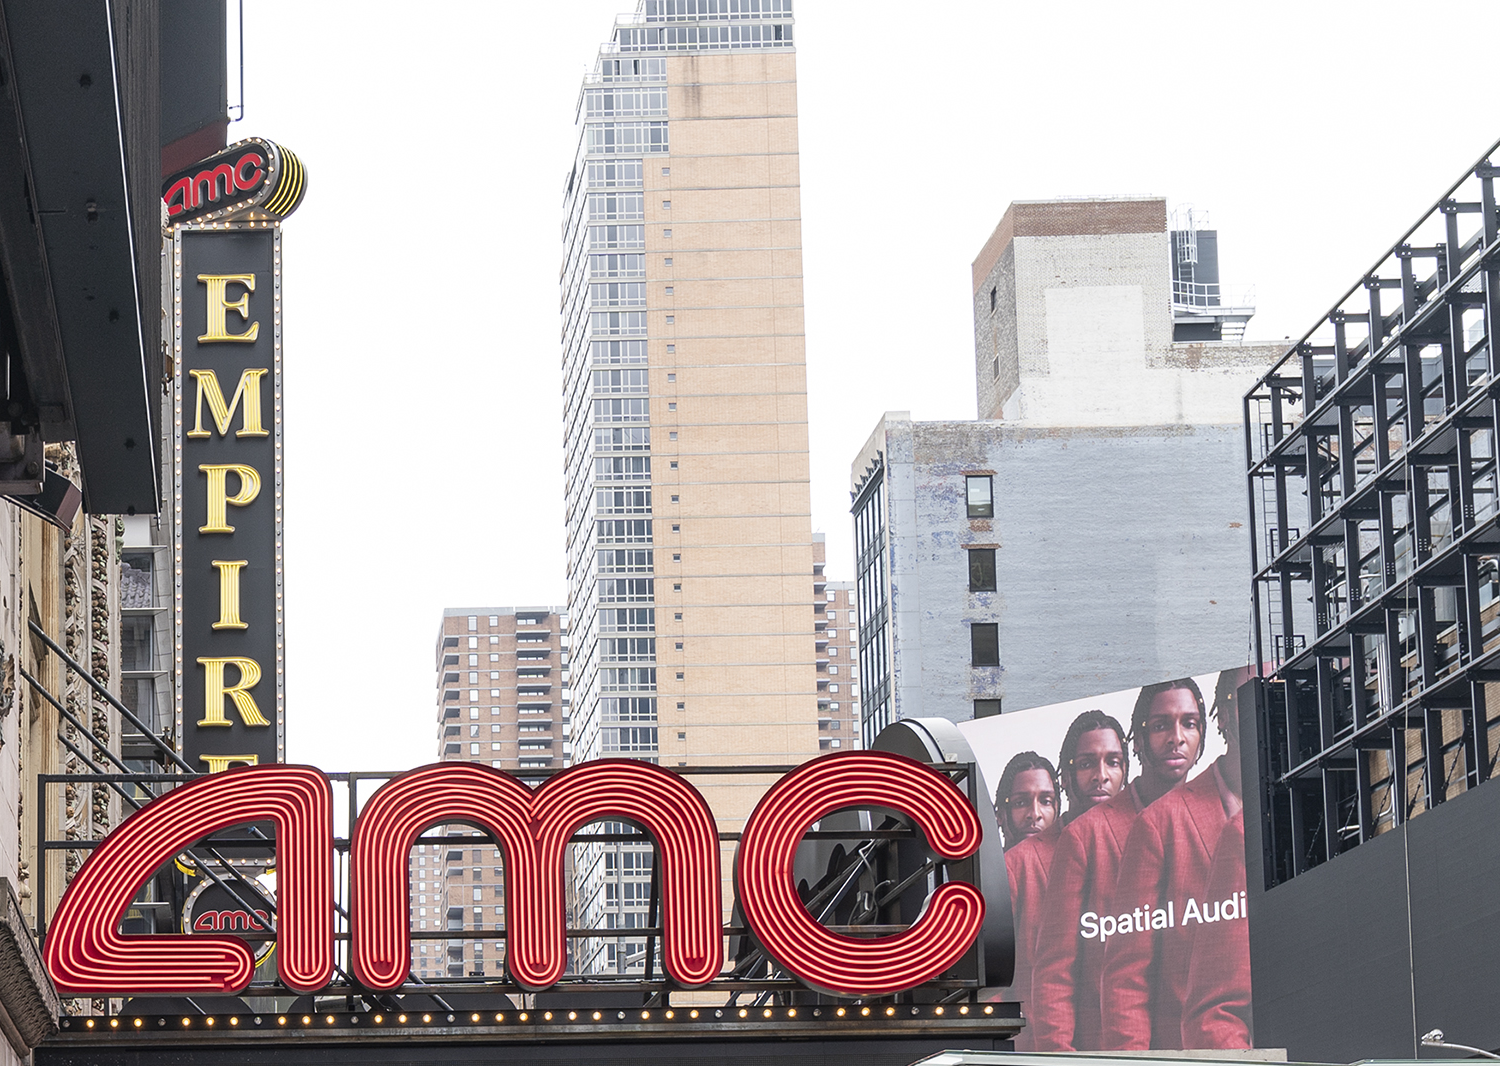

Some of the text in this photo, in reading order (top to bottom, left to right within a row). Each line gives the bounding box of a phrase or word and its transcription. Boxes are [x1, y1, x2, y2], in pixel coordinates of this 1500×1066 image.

[162, 152, 265, 217] amc
[44, 750, 987, 996] amc
[193, 909, 270, 931] amc
[1079, 892, 1247, 942] Spatial Audi
